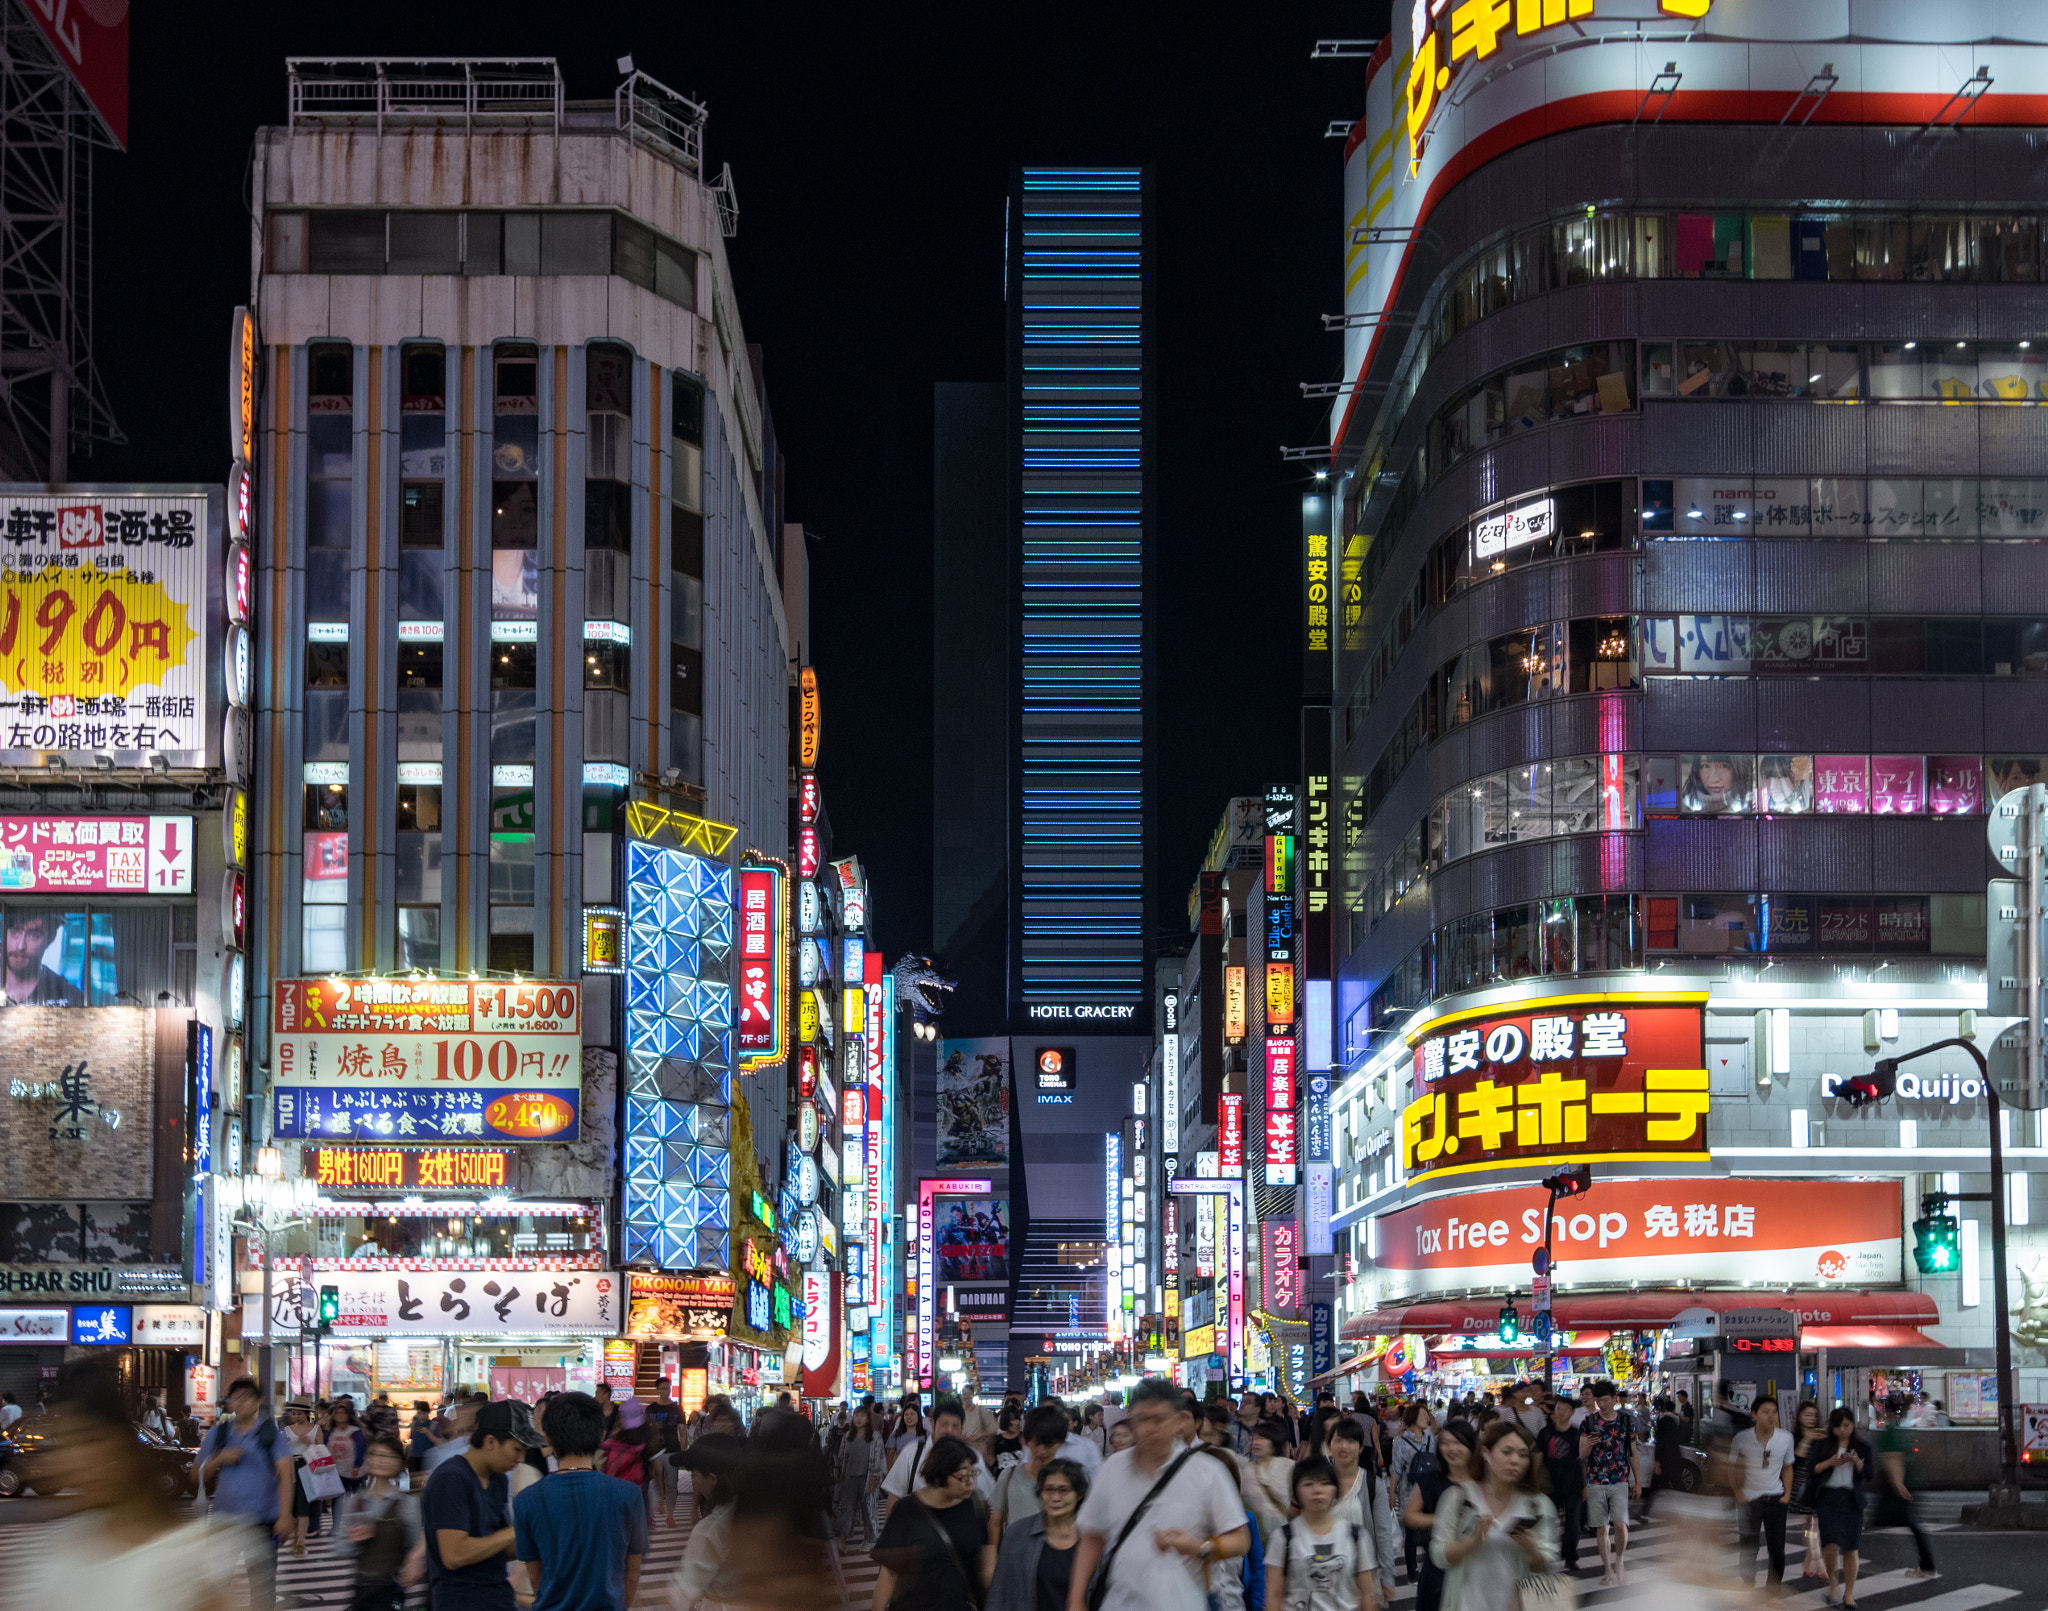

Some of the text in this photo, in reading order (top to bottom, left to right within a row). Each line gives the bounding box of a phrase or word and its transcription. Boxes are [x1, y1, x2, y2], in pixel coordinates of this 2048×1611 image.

[1713, 489, 1776, 500] namco
[0, 507, 195, 548] 軒め酒場
[95, 554, 125, 567] 白鶴
[1307, 534, 1328, 651] 驚安の殿堂
[8, 724, 180, 749] 左の路地を右へ
[1817, 768, 1977, 794] 東京 アイ ドル
[110, 852, 141, 867] TAX
[109, 868, 142, 884] FREE
[155, 869, 186, 886] 1F
[745, 889, 766, 955] 居酒屋
[1268, 908, 1280, 949] Elle de
[1280, 902, 1293, 939] Castle
[1820, 912, 1869, 929] ブランド
[1879, 911, 1927, 928] 時計
[1821, 929, 1869, 942] BRAND
[1878, 928, 1927, 941] WATCH
[334, 983, 470, 1011] 2時間飲み放題
[478, 987, 575, 1019] ¥1,500
[332, 1013, 471, 1031] ポテトフライ食べ放題
[1030, 1006, 1135, 1018] HOTEL GRACERY
[1164, 994, 1177, 1029] Booth
[1272, 1024, 1288, 1034] 6F
[279, 1042, 295, 1078] 6F
[1423, 1012, 1627, 1082] 驚安の殿堂
[336, 1042, 408, 1080] 焼鳥
[1272, 1058, 1289, 1109] 居楽屋
[332, 1090, 484, 1110] しゃぶしゃぶ VS すきやき
[513, 1093, 544, 1102] 食べ放題
[1037, 1095, 1073, 1104] IMAX
[278, 1094, 294, 1131] 5F
[331, 1110, 485, 1136] 選べる食べ放題
[1266, 1113, 1295, 1163] 笑笑
[317, 1150, 505, 1186] 男性1600円 女性1500円
[1416, 1203, 1756, 1257] Tax Free Shop 免税店
[958, 1264, 986, 1273] 10.14
[1274, 1226, 1294, 1308] カラオケ
[1857, 1251, 1884, 1261] Japan.
[632, 1276, 736, 1294] OKONOMI YAKI
[921, 1210, 931, 1359] GODZILLA ROAD
[1232, 1224, 1241, 1348] ゴジラロード
[398, 1277, 581, 1323] とらそば
[959, 1293, 1005, 1305] MARUHAN
[1463, 1316, 1495, 1329] Don
[1797, 1308, 1832, 1325] jote
[1055, 1342, 1080, 1352] TOHO
[1314, 1307, 1329, 1374] カラオケ
[1291, 1343, 1305, 1396] カラオケ
